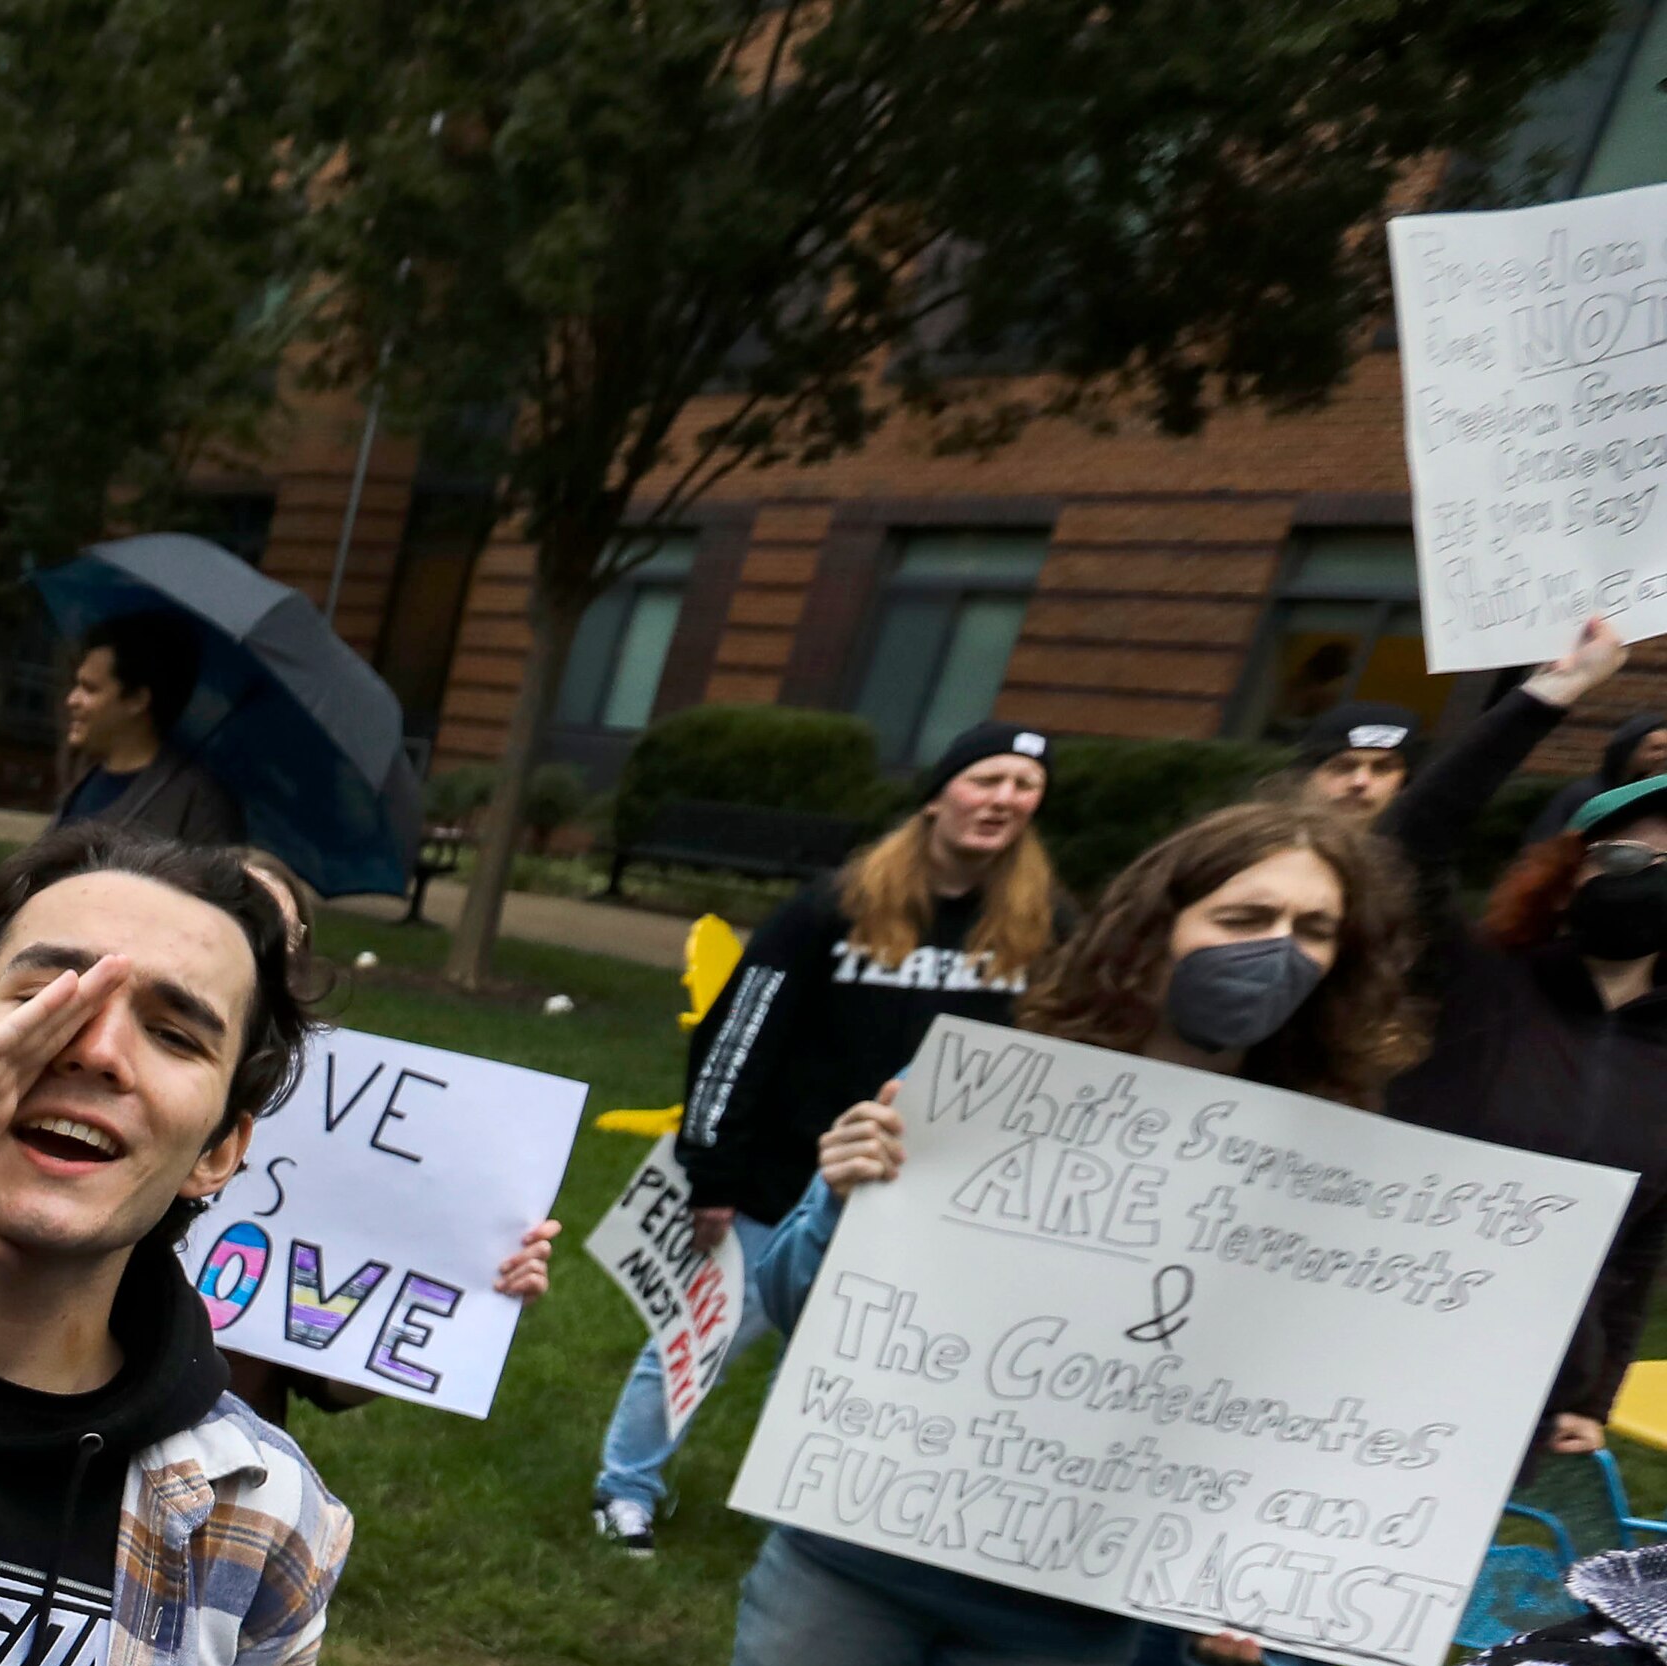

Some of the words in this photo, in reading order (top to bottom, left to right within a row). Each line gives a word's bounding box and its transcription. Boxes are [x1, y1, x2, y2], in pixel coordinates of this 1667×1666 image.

[927, 1031, 1171, 1160] White
[948, 1137, 1169, 1249] ARE
[834, 1269, 971, 1384] The
[1123, 1264, 1195, 1351] &
[776, 1431, 1140, 1578] FUCKING
[1255, 1488, 1440, 1550] and
